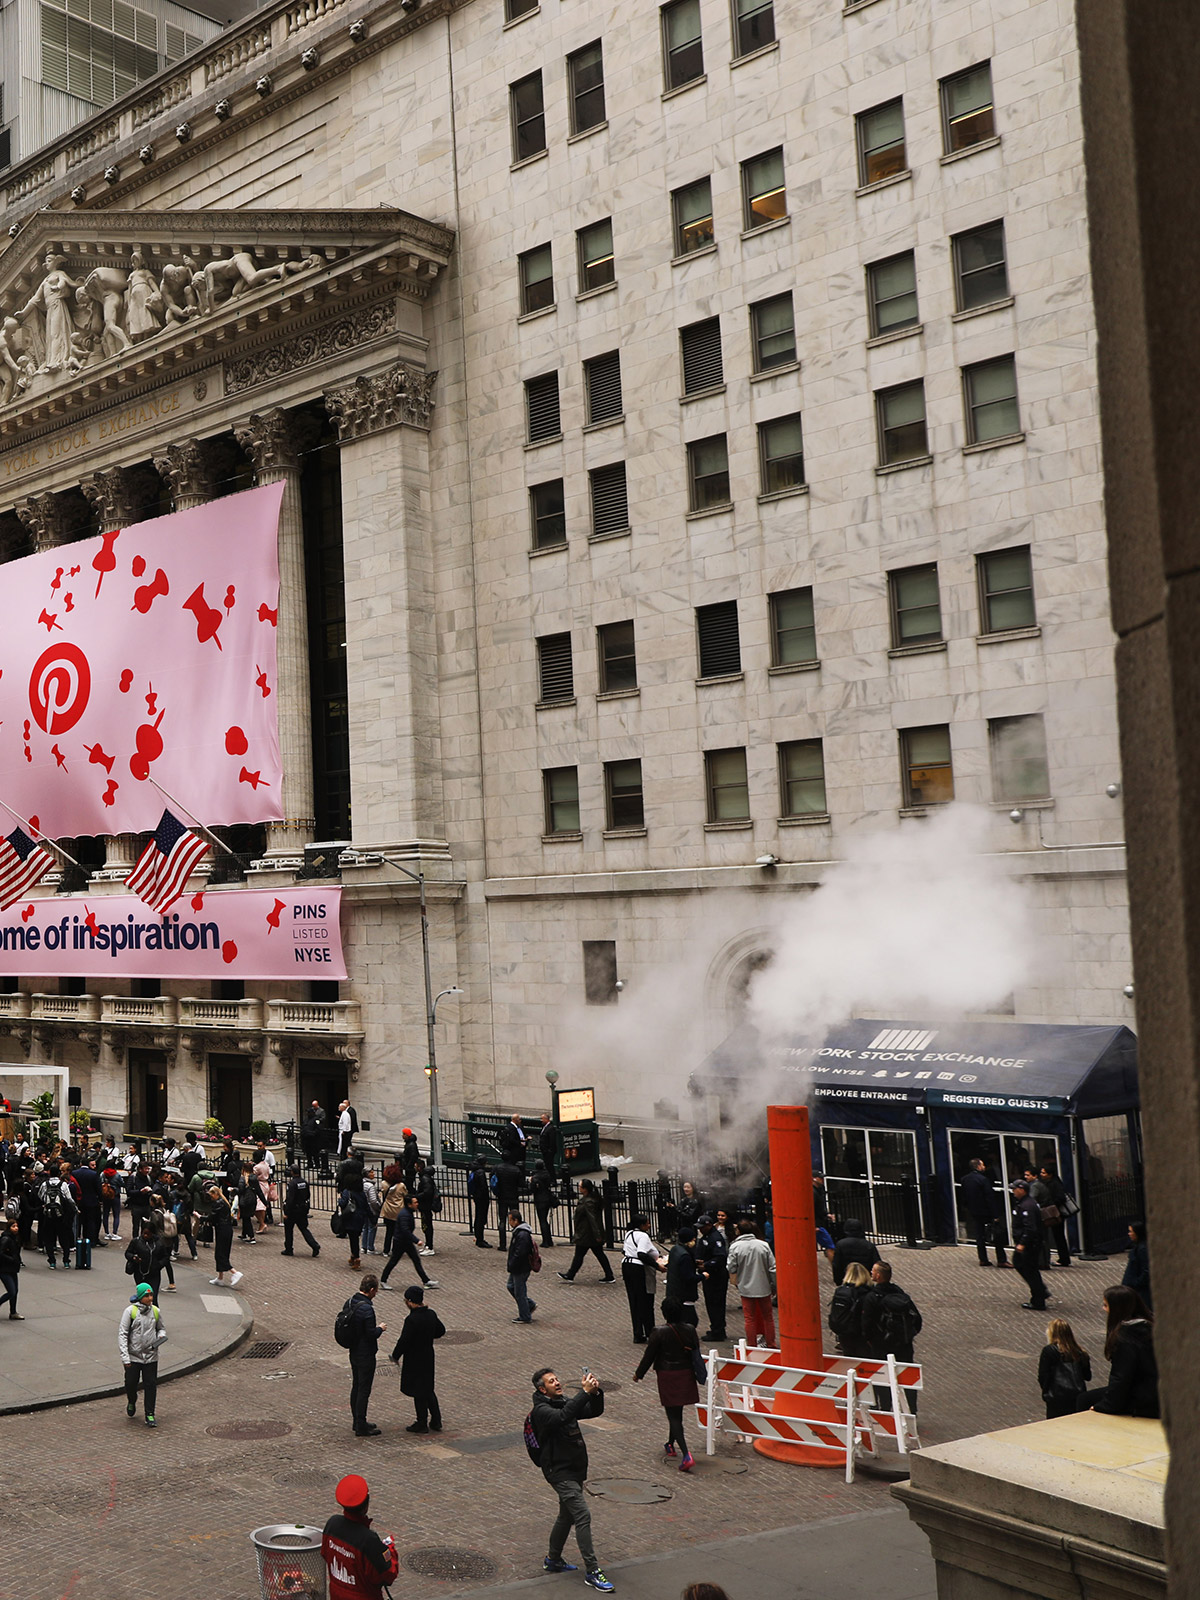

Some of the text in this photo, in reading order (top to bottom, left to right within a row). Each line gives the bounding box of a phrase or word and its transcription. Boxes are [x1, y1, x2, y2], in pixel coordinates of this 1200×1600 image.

[4, 448, 40, 476] YORK
[47, 428, 91, 459] STOCK
[99, 392, 180, 439] EXCHANGE
[294, 904, 327, 919] PINS
[44, 916, 70, 950] of
[73, 913, 220, 957] inspiration
[293, 929, 329, 938] LISTED
[294, 948, 332, 962] NYSE
[809, 1048, 857, 1059] YORK
[858, 1051, 920, 1061] STOCK
[832, 1068, 867, 1076] NYSE
[814, 1089, 908, 1101] EMPLOYEE ENTRANCE
[942, 1094, 1049, 1109] REGISTERED GUESTS
[472, 1126, 498, 1138] Subway
